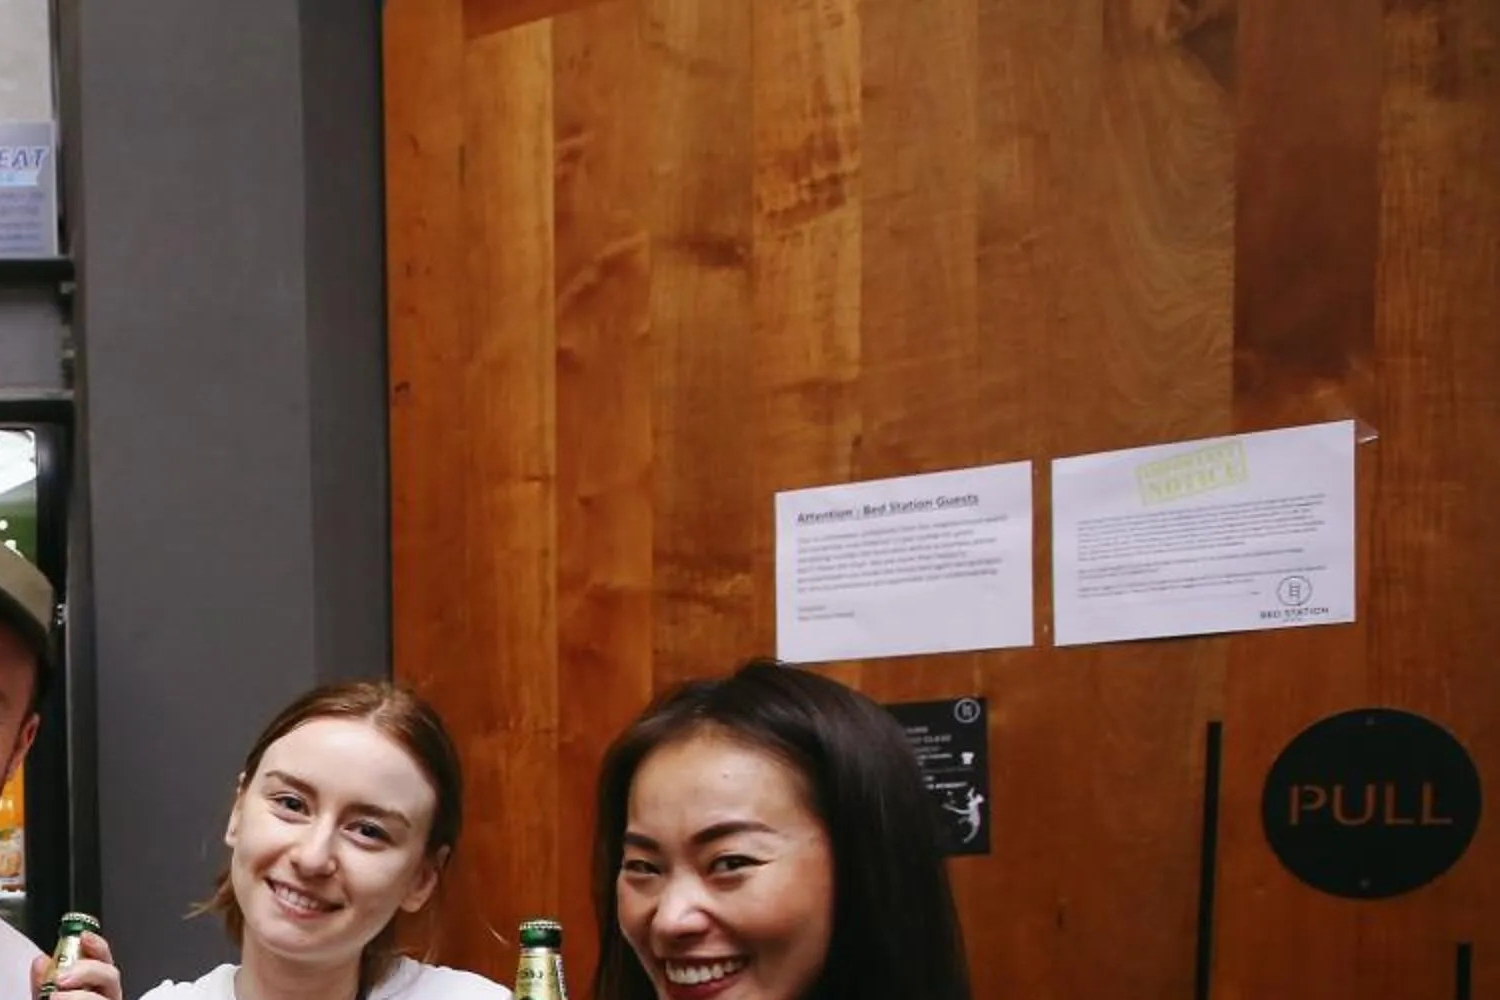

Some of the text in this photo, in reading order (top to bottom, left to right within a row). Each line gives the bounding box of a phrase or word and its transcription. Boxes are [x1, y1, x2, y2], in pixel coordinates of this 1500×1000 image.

[797, 508, 853, 523] Attention
[863, 504, 886, 516] Bed
[890, 499, 933, 512] Station
[936, 493, 979, 506] Guests
[1288, 783, 1453, 826] PULL
